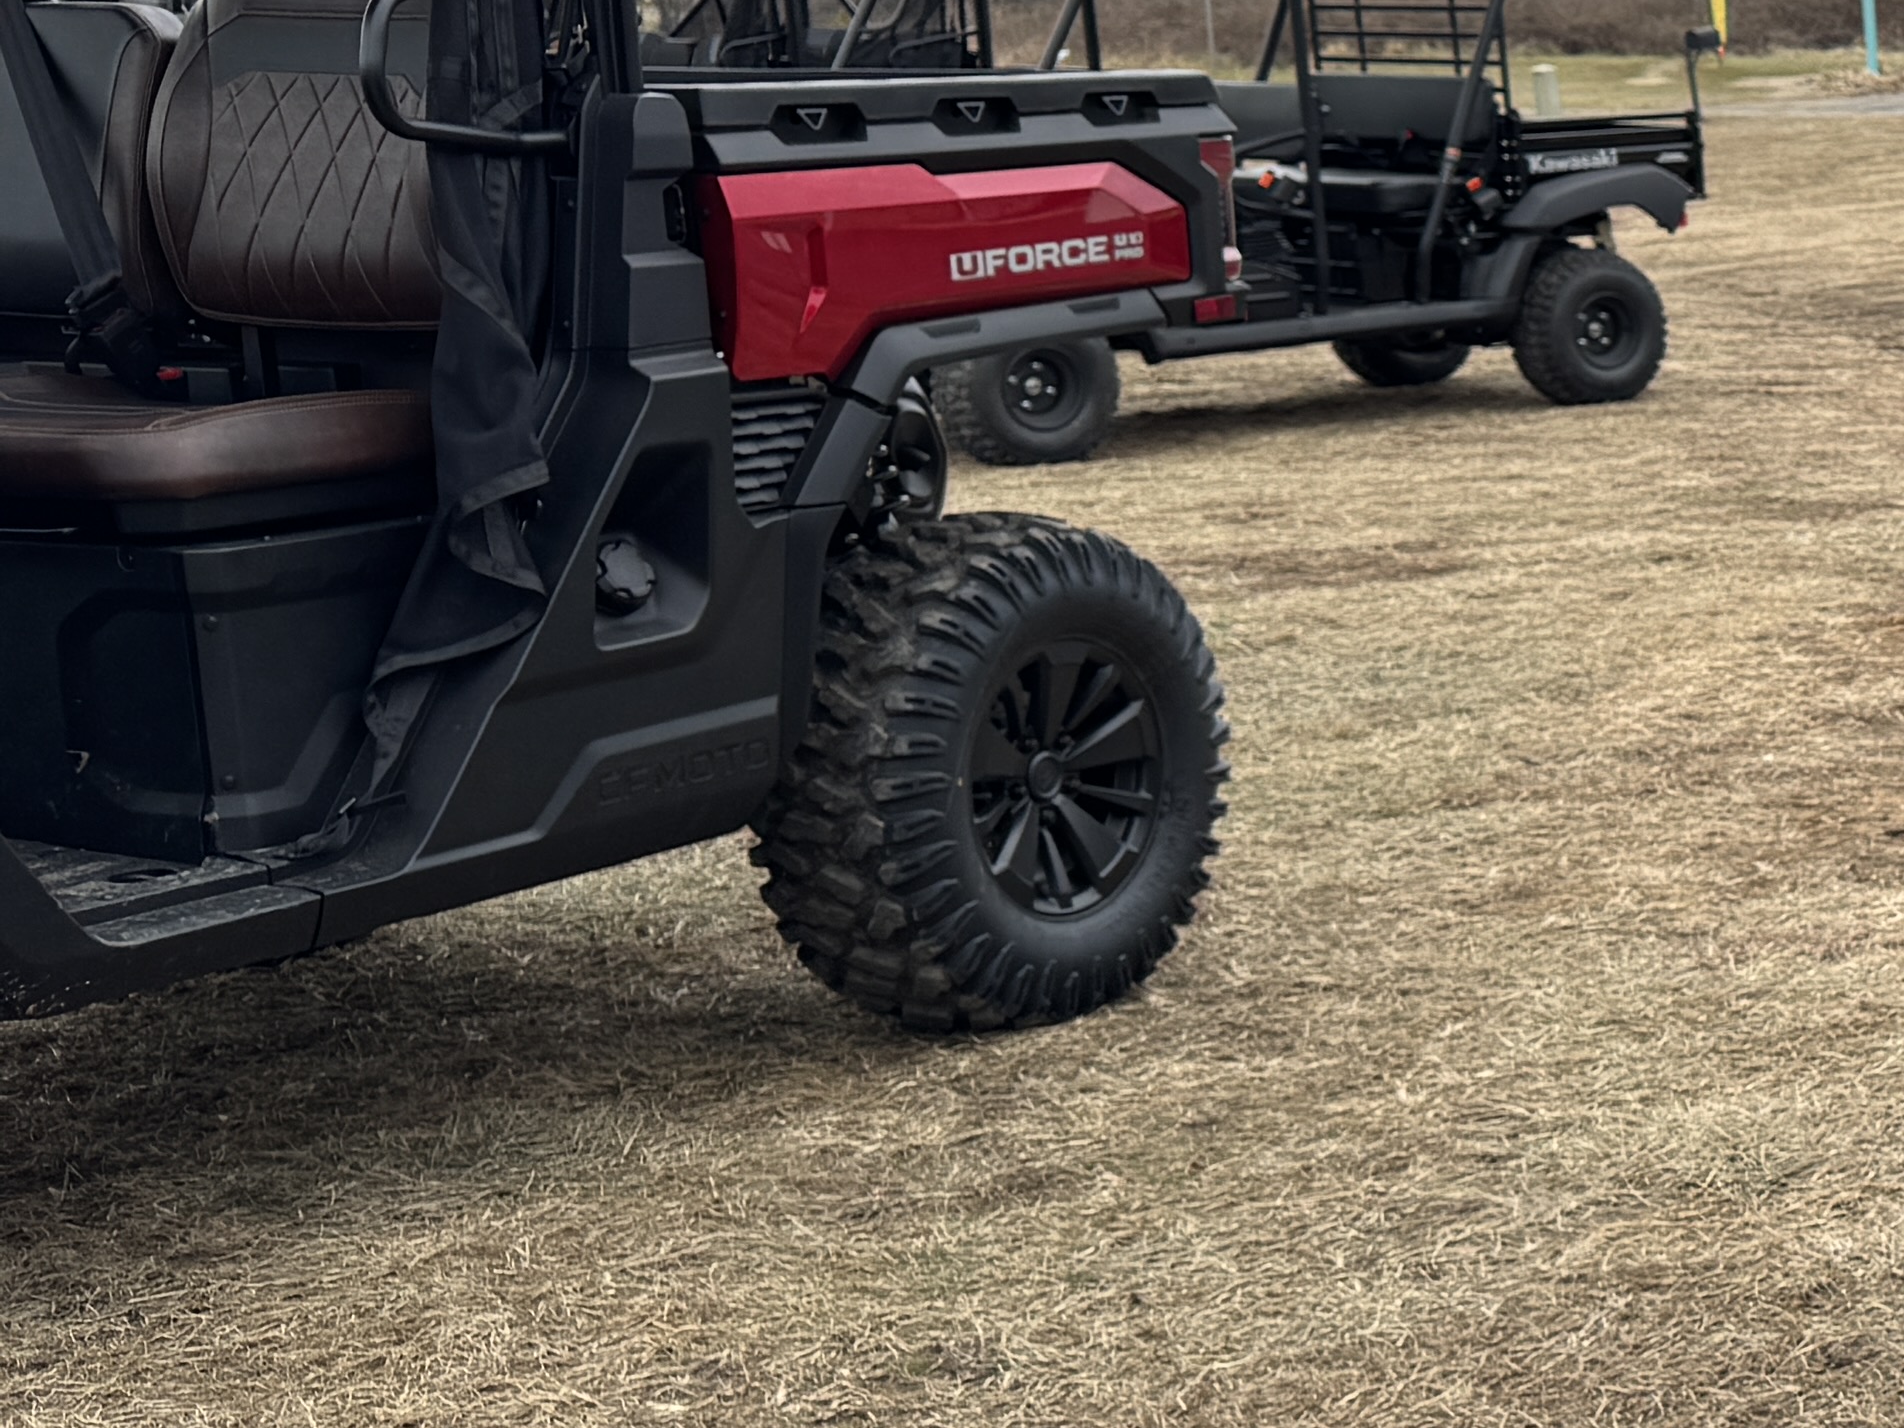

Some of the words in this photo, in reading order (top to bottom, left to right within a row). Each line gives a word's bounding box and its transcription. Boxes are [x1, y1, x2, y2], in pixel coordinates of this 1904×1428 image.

[949, 235, 1111, 282] UFORCE
[1114, 246, 1145, 261] PRO
[600, 741, 769, 805] CFMOTO
